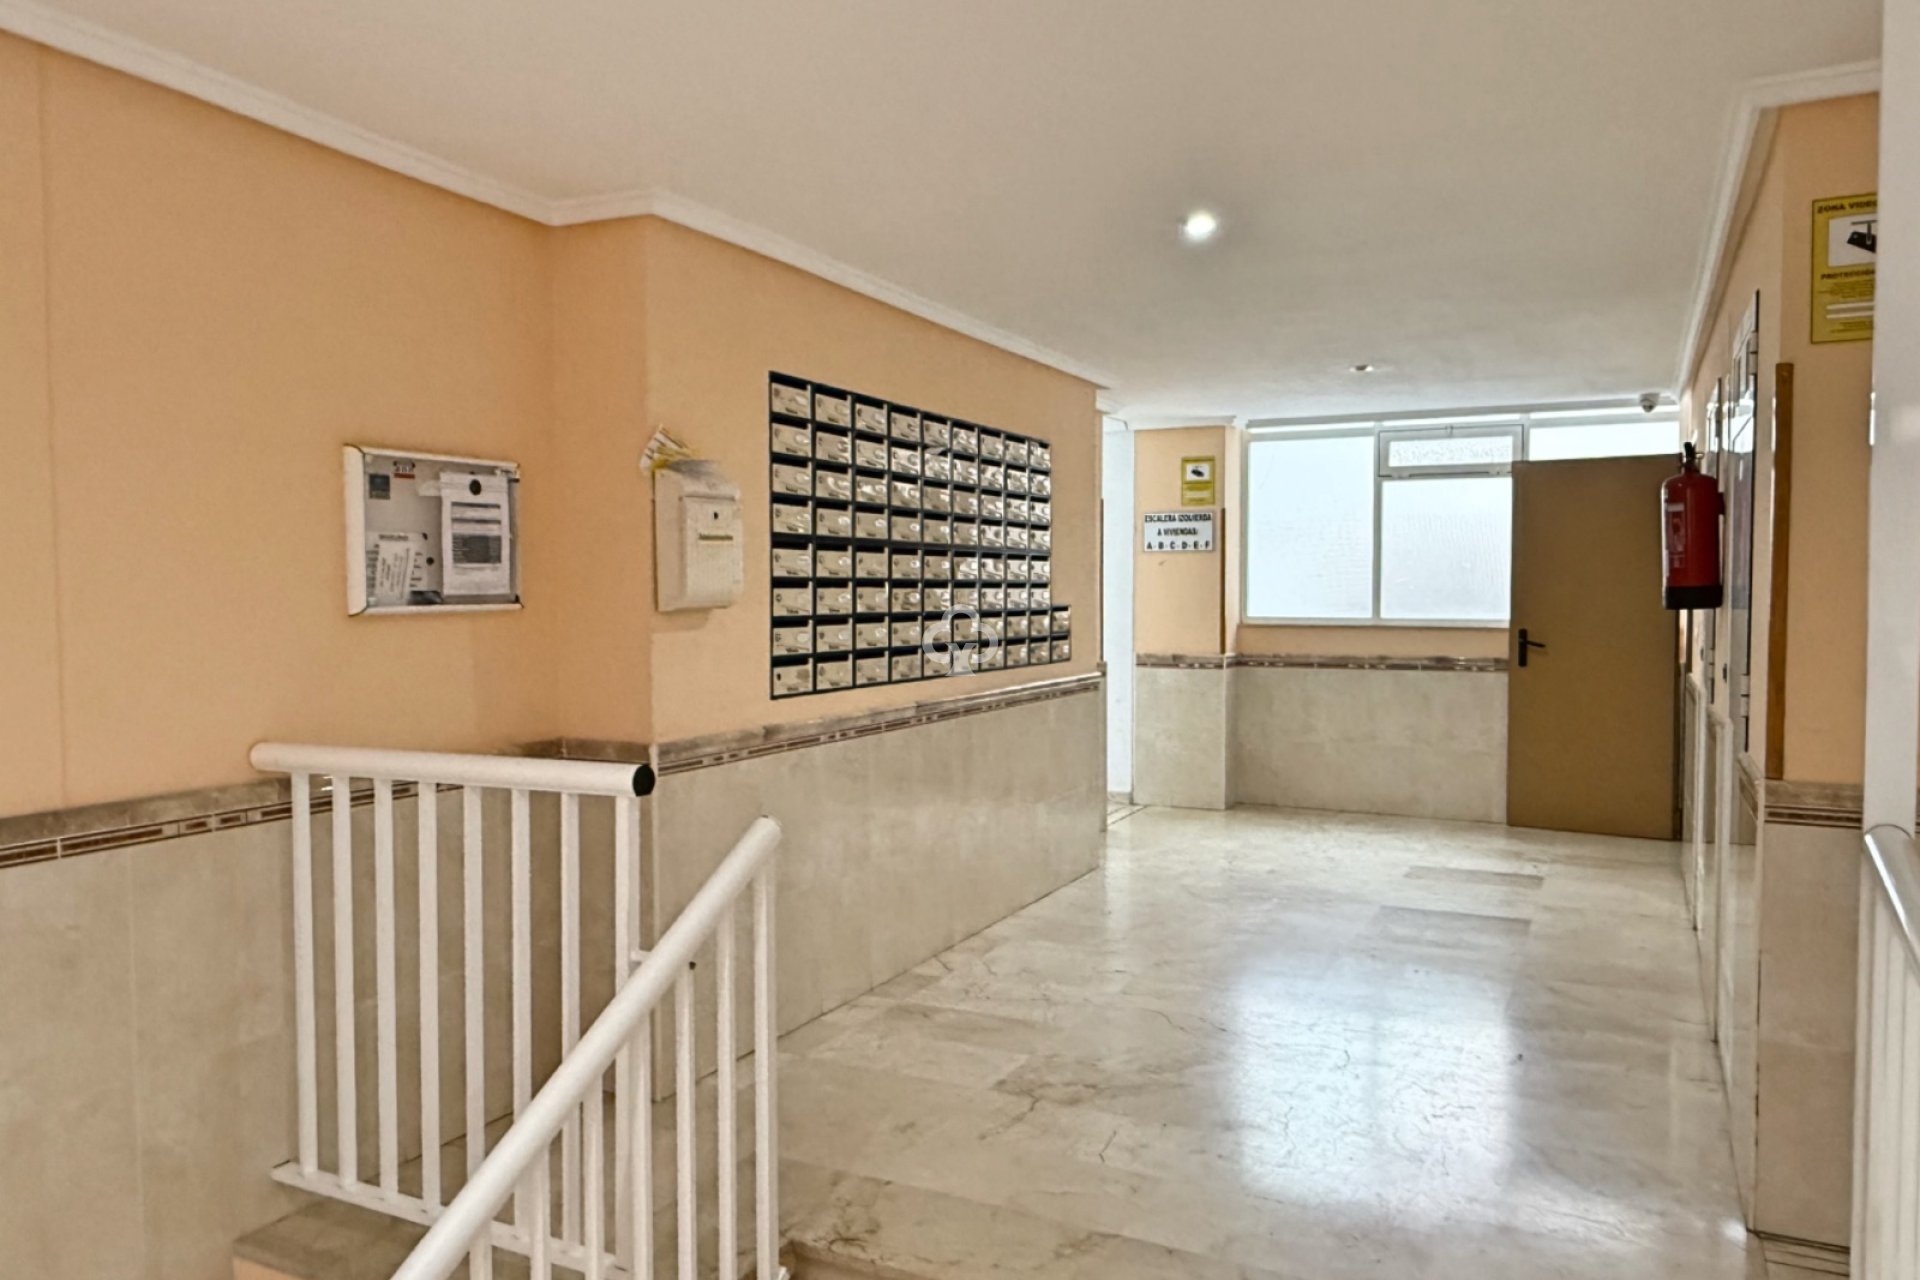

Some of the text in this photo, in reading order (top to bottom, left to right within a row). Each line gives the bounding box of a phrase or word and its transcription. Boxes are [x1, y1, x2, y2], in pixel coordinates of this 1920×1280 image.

[1144, 513, 1211, 522] ESCALERA IZQUIERDA
[1146, 540, 1210, 550] A B C D E F
